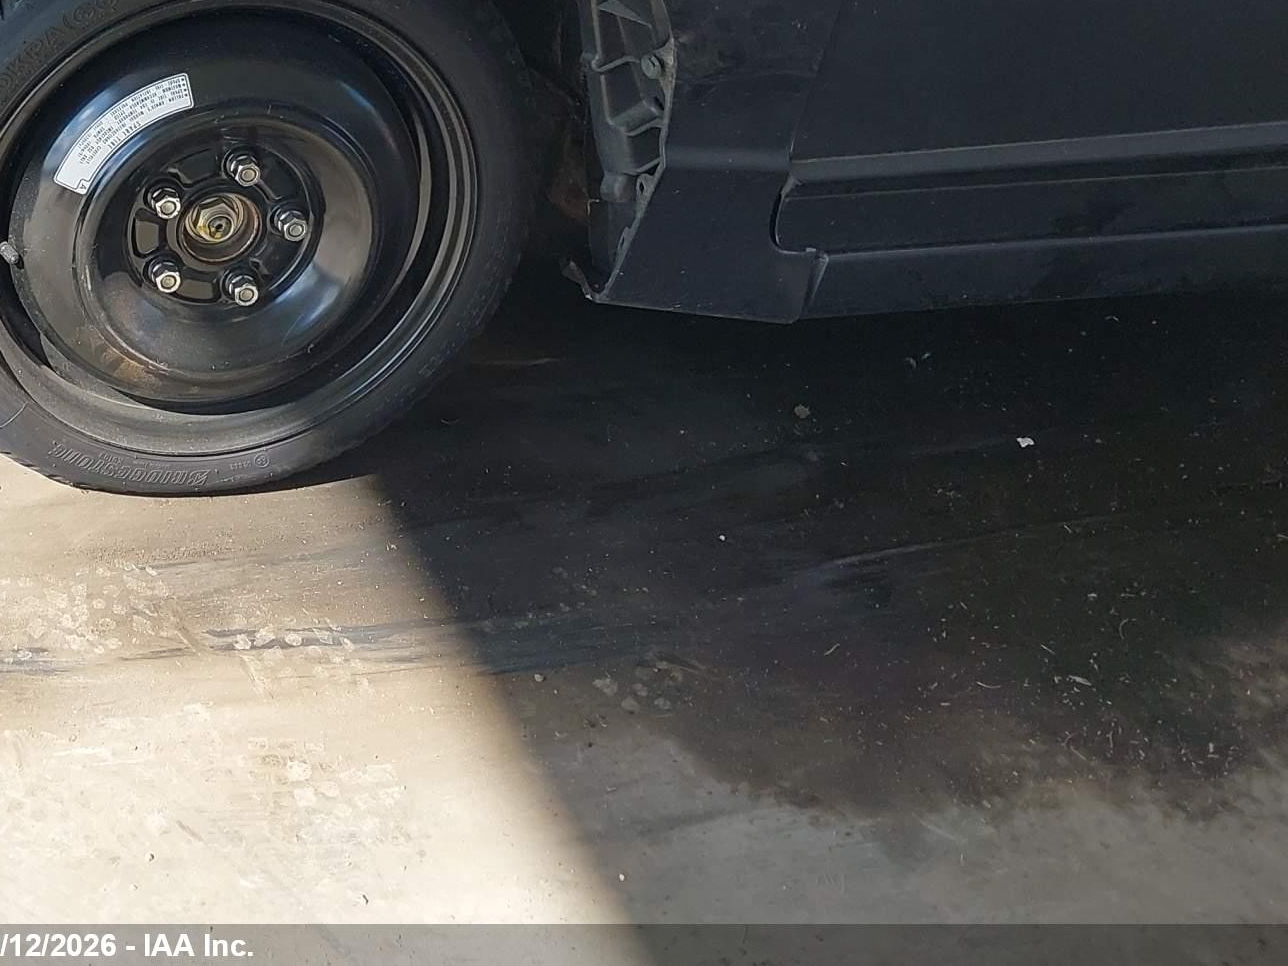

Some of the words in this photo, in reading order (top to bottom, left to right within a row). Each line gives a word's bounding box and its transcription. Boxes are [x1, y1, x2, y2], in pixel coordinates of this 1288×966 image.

[119, 119, 141, 137] SPARE
[105, 134, 122, 150] TIRE
[48, 442, 210, 488] BRIDGESTONE
